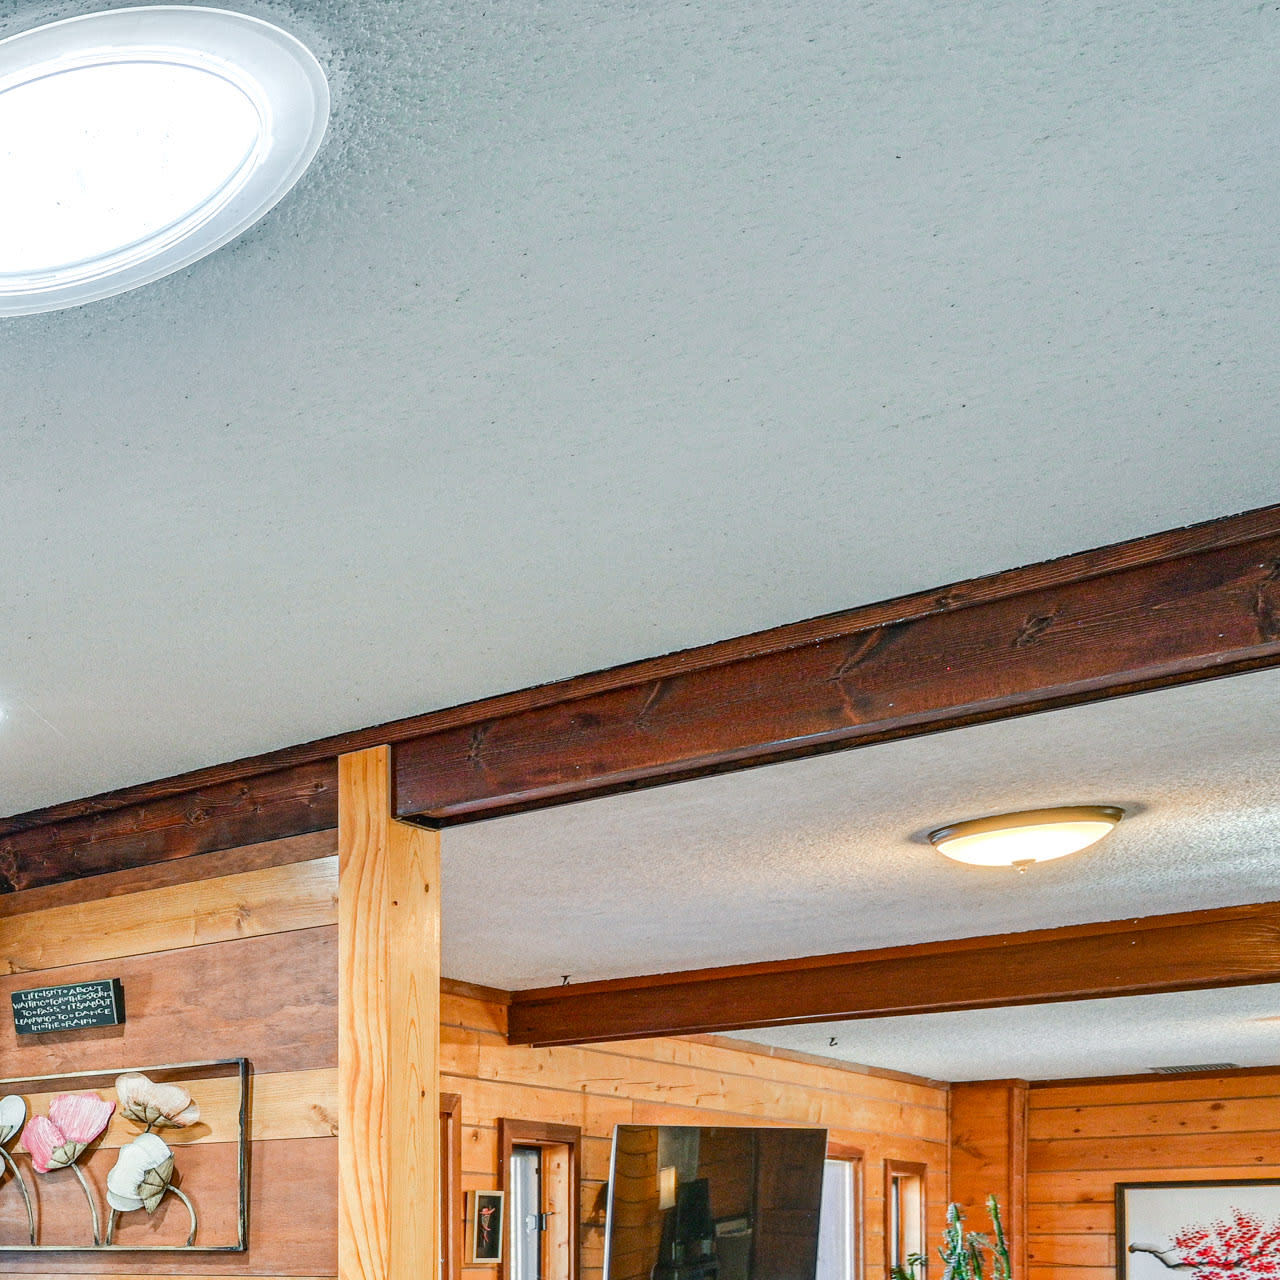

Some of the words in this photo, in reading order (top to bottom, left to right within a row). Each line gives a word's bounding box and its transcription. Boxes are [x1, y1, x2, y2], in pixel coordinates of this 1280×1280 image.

[69, 986, 103, 994] ABOUT
[13, 1001, 46, 1009] WAITING
[86, 999, 111, 1007] ABOUT
[16, 1016, 51, 1025] LEARNING
[66, 1018, 92, 1027] RAIN
